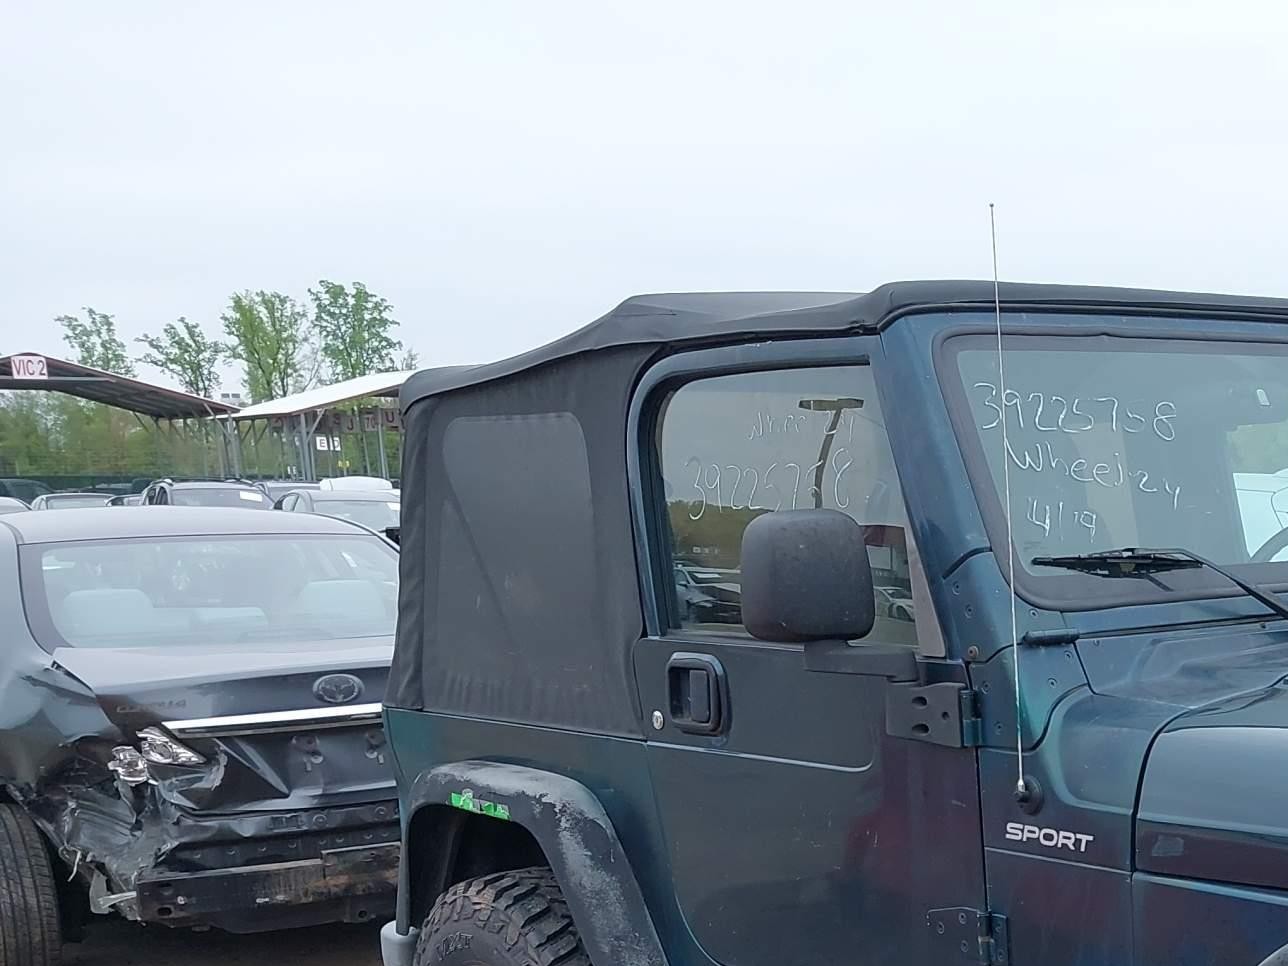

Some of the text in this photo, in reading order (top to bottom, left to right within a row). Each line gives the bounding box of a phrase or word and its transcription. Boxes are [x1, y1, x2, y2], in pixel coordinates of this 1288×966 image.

[13, 359, 46, 376] VIC 2
[974, 382, 1177, 441] 39225758
[1005, 822, 1095, 852] SPORT
